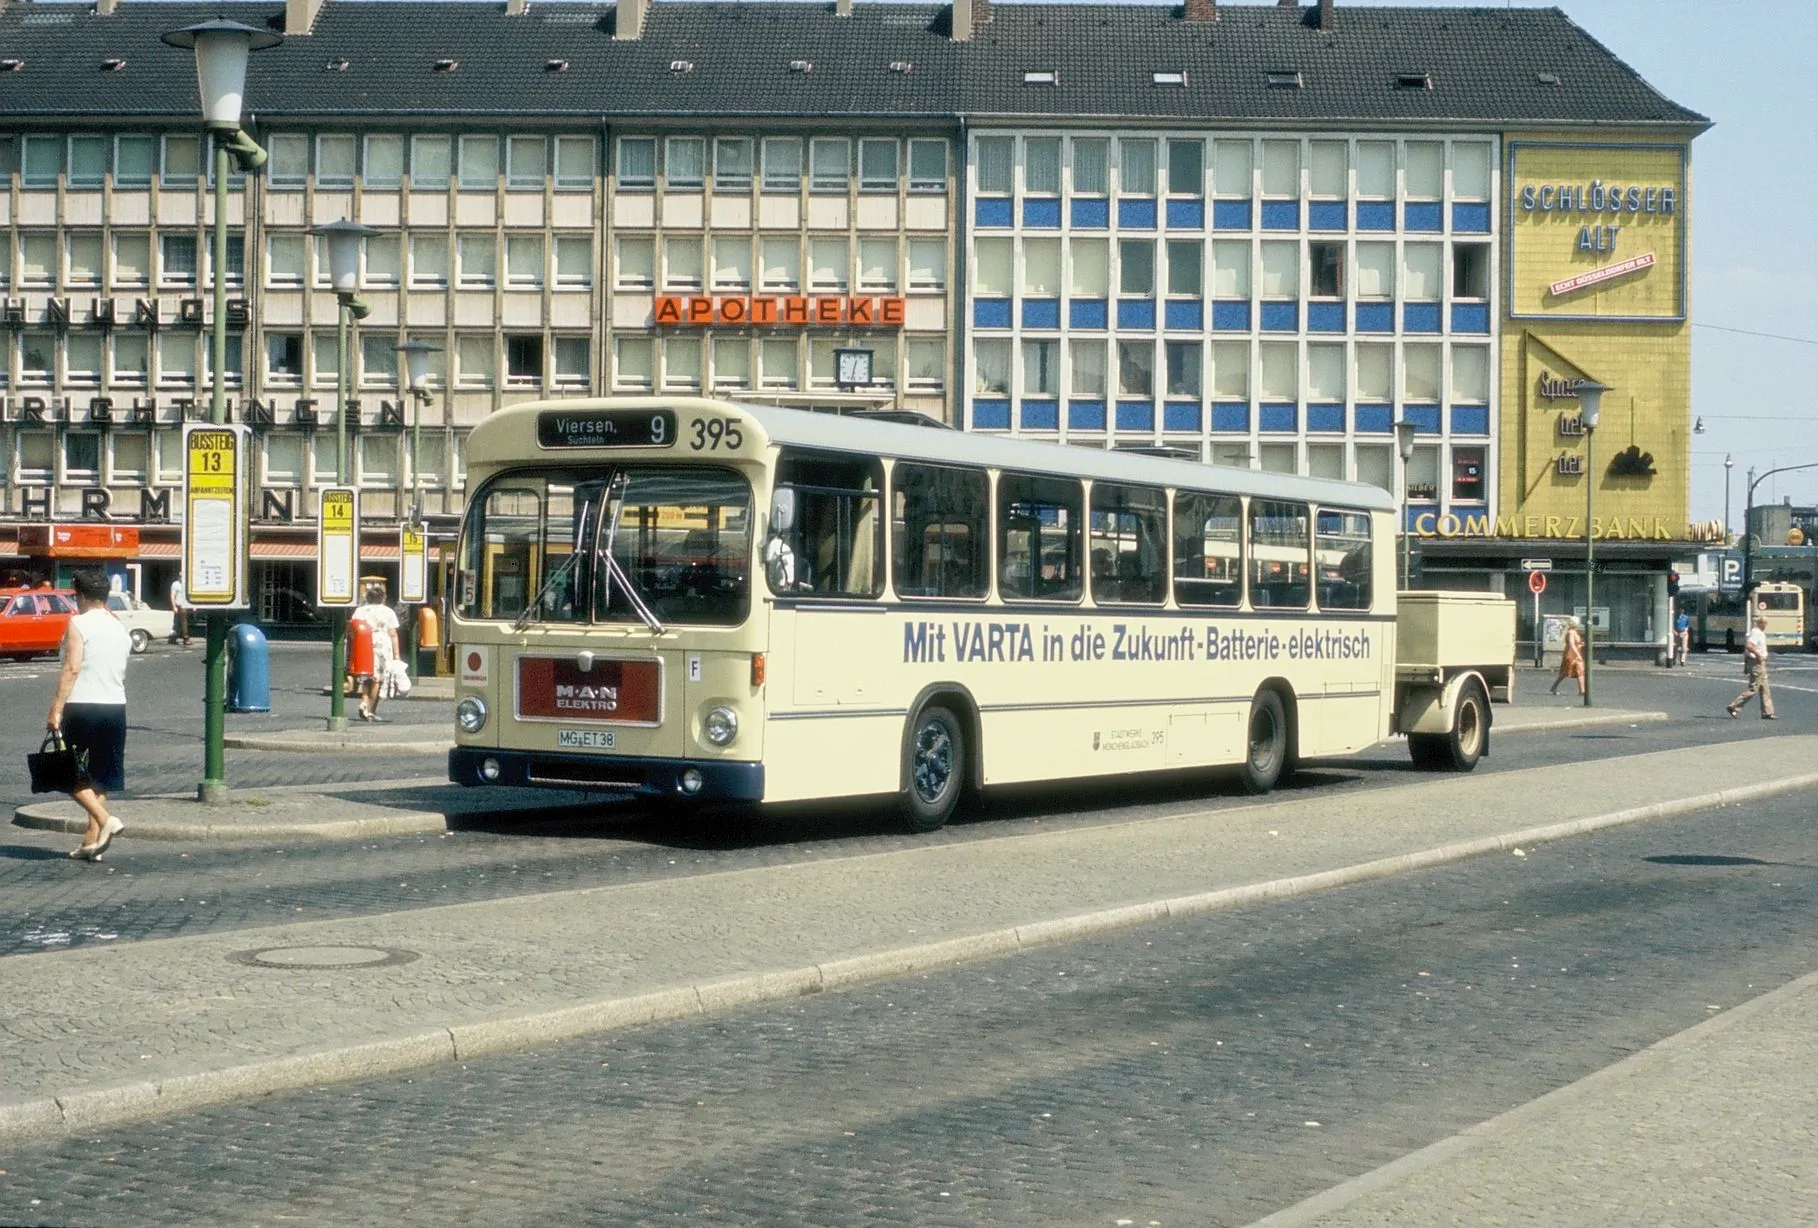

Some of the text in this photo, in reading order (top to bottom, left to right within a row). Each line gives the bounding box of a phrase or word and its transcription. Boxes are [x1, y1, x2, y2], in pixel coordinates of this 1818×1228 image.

[1522, 179, 1676, 214] SCHLÖSSER
[1579, 224, 1620, 251] ALT
[1554, 280, 1575, 291] ECHT
[657, 298, 902, 322] APOTHEKE
[556, 417, 618, 434] Viersen,
[651, 415, 665, 443] 9
[690, 417, 743, 451] 395
[190, 434, 234, 450] BUSSTEIG
[202, 452, 221, 472] 13
[331, 504, 344, 518] 14
[1415, 513, 1672, 541] COMMERZBANK
[1724, 559, 1740, 581] P
[903, 622, 946, 663] Mit
[953, 622, 1035, 663] VARTA
[1043, 624, 1063, 662] in
[1071, 624, 1105, 661] die
[691, 660, 698, 677] F
[556, 699, 617, 711] ELEKTRO
[1152, 730, 1165, 744] 395
